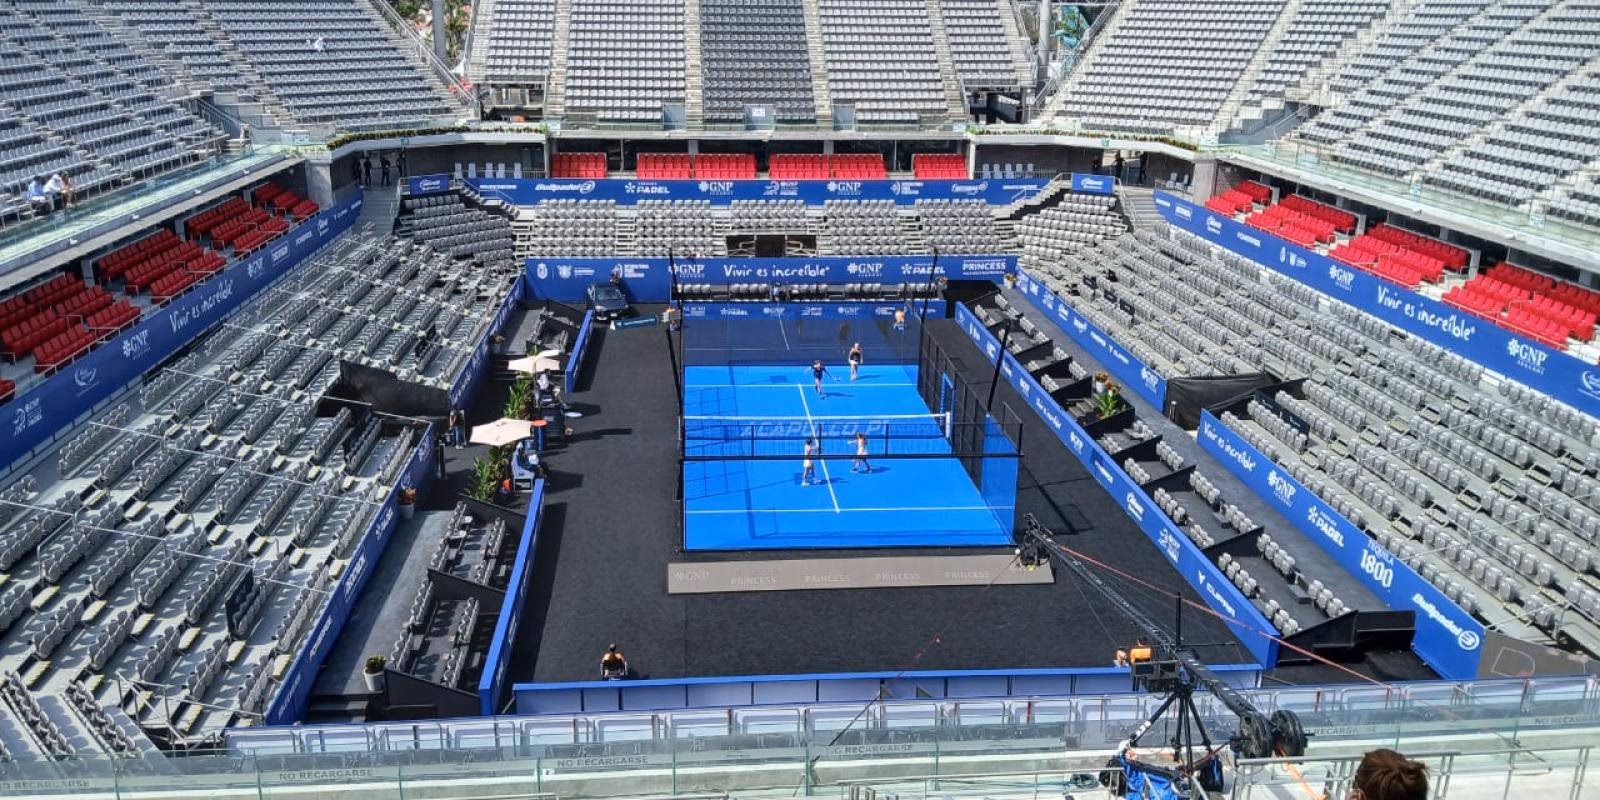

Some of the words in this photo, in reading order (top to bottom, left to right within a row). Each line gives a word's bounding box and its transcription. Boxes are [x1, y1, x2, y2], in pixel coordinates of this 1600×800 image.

[637, 186, 670, 194] PADEL
[709, 182, 734, 191] GNP
[838, 182, 861, 191] GNP
[680, 264, 705, 274] GNP
[723, 264, 753, 277] Vivir
[756, 269, 768, 277] es
[859, 263, 883, 273] GNP
[962, 261, 1006, 271] PRINCESS
[1336, 268, 1355, 285] GNP
[1377, 284, 1403, 310] Vivir
[1404, 302, 1415, 318] es
[169, 305, 190, 333] Vivir
[191, 304, 200, 319] es
[1519, 343, 1547, 366] GNP
[1275, 476, 1297, 500] GNP
[1316, 517, 1345, 548] PADEL
[1360, 548, 1394, 588] 1800
[1411, 593, 1463, 637] Bullpadel
[557, 759, 573, 768] NO
[577, 755, 649, 766] RECARGARSE
[280, 773, 296, 781] NO
